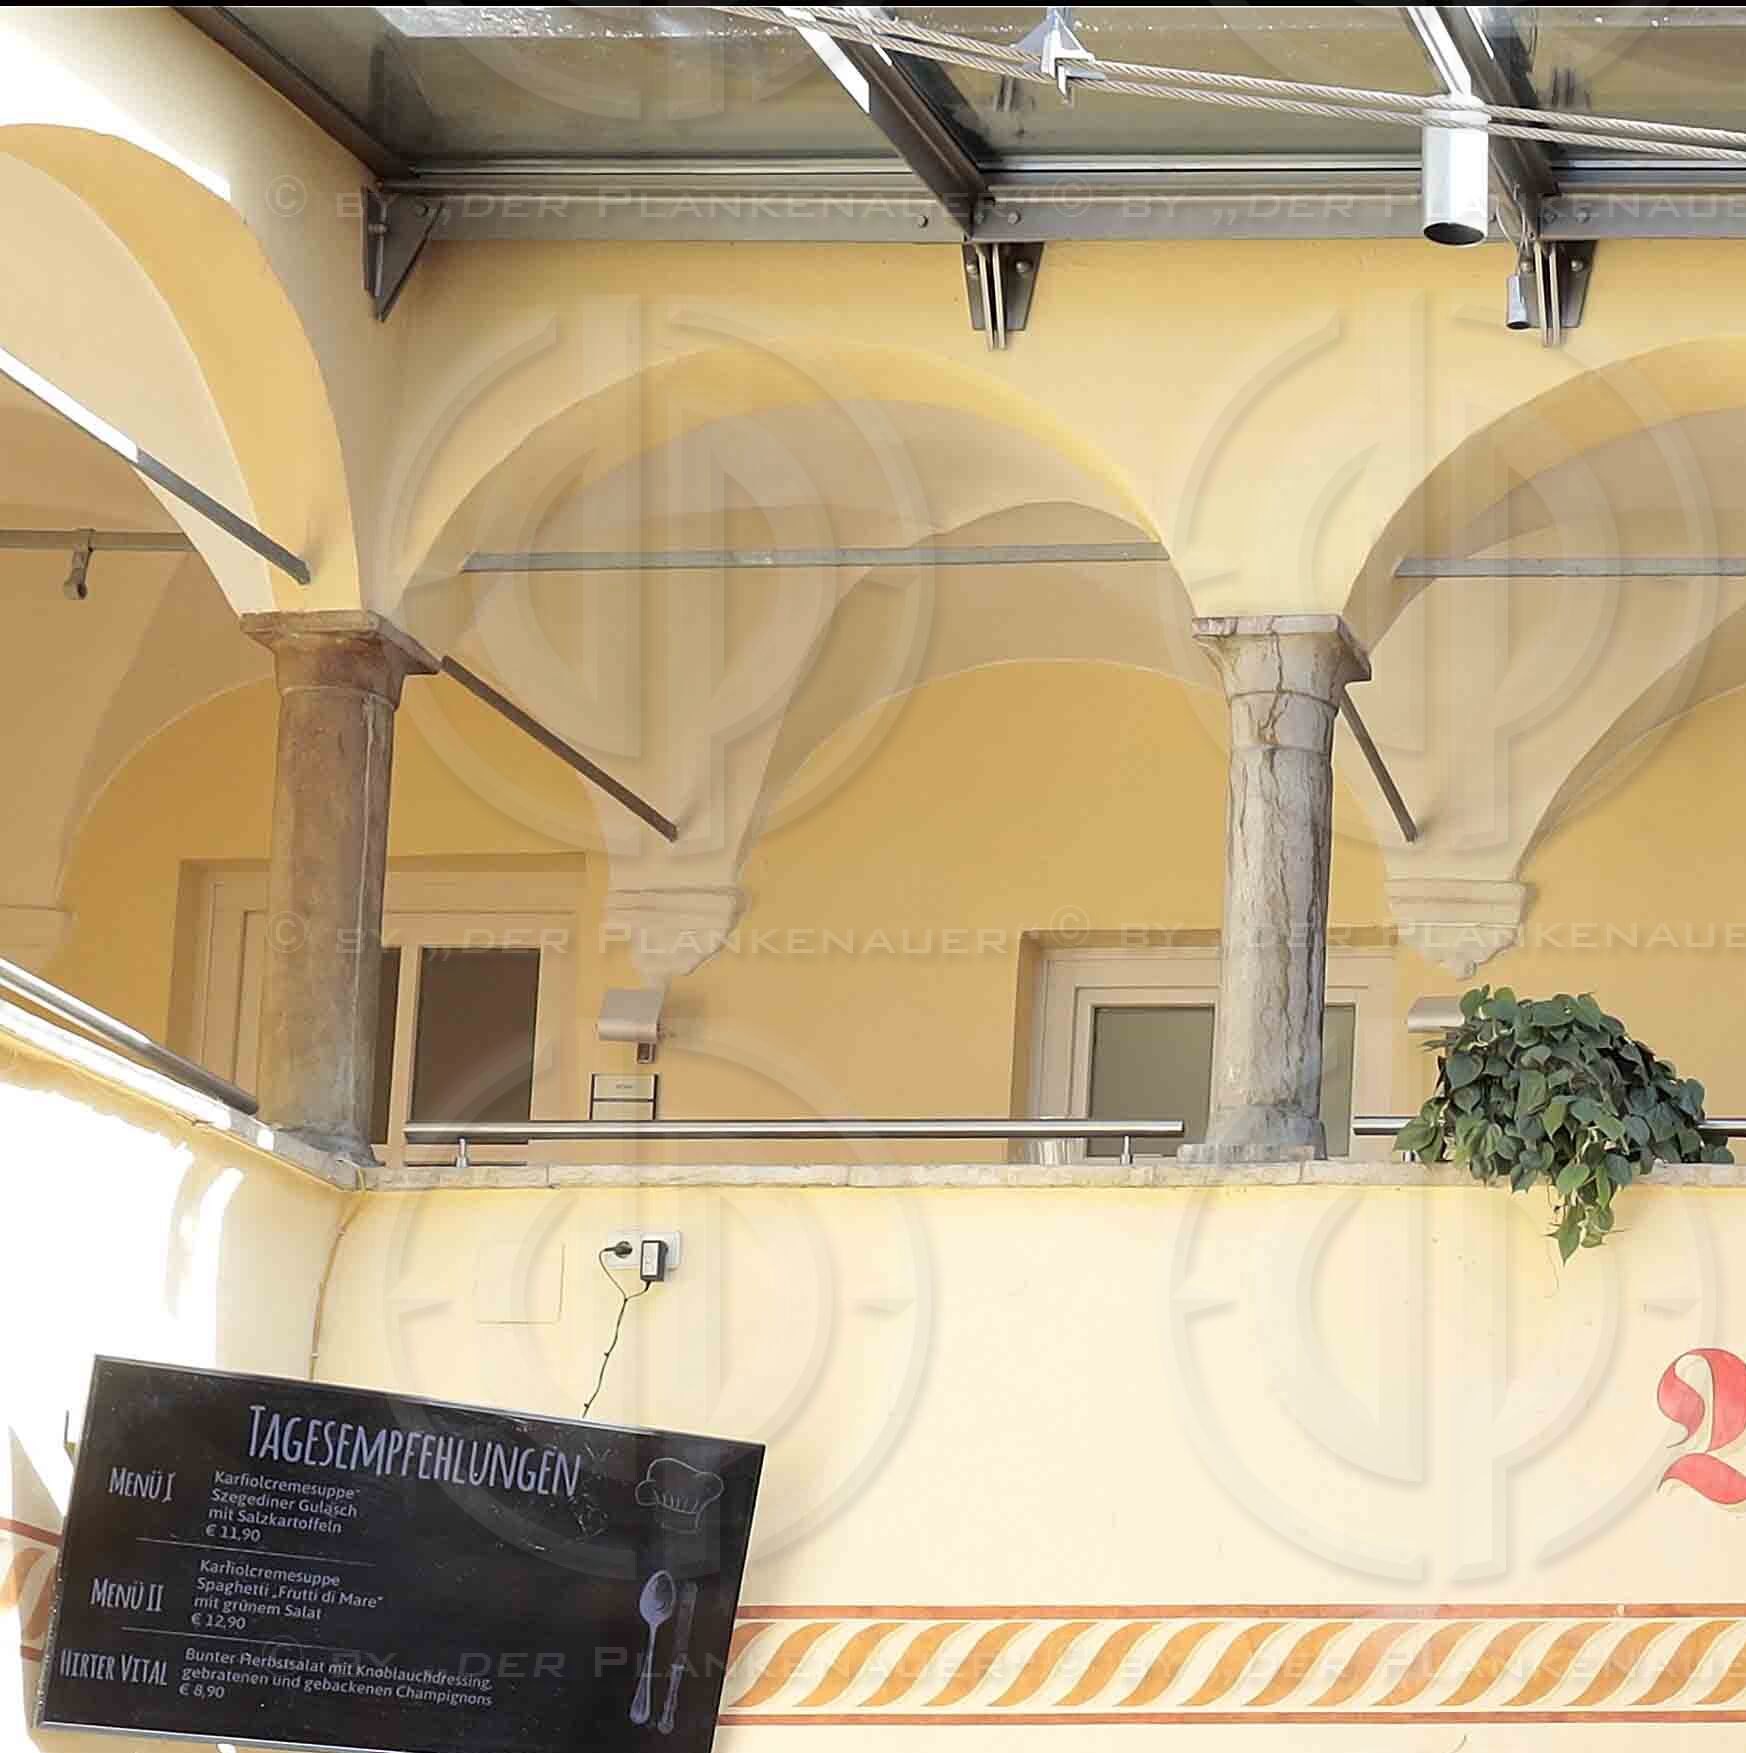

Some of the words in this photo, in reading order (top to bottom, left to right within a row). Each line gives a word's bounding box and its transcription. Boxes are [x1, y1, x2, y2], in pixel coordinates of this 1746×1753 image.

[249, 1404, 582, 1498] TAGESEMPFEHLUNGEN
[212, 1489, 295, 1512] Szegediner
[299, 1499, 358, 1518] Gulasch
[209, 1506, 235, 1520] mit
[237, 1508, 342, 1535] Salzkartoffeln
[221, 1525, 261, 1542] 11,90
[197, 1577, 269, 1600] Spaghetti
[326, 1590, 336, 1604] di
[194, 1596, 219, 1610] mit
[222, 1599, 281, 1618] grünem
[285, 1603, 322, 1620] Salat
[205, 1614, 246, 1630] 12,90
[185, 1647, 235, 1664] Bunter
[328, 1661, 352, 1675] mit
[182, 1666, 270, 1686] gebratenen
[272, 1673, 300, 1688] und
[303, 1677, 393, 1697] gebackenen
[396, 1685, 492, 1706] Champignons
